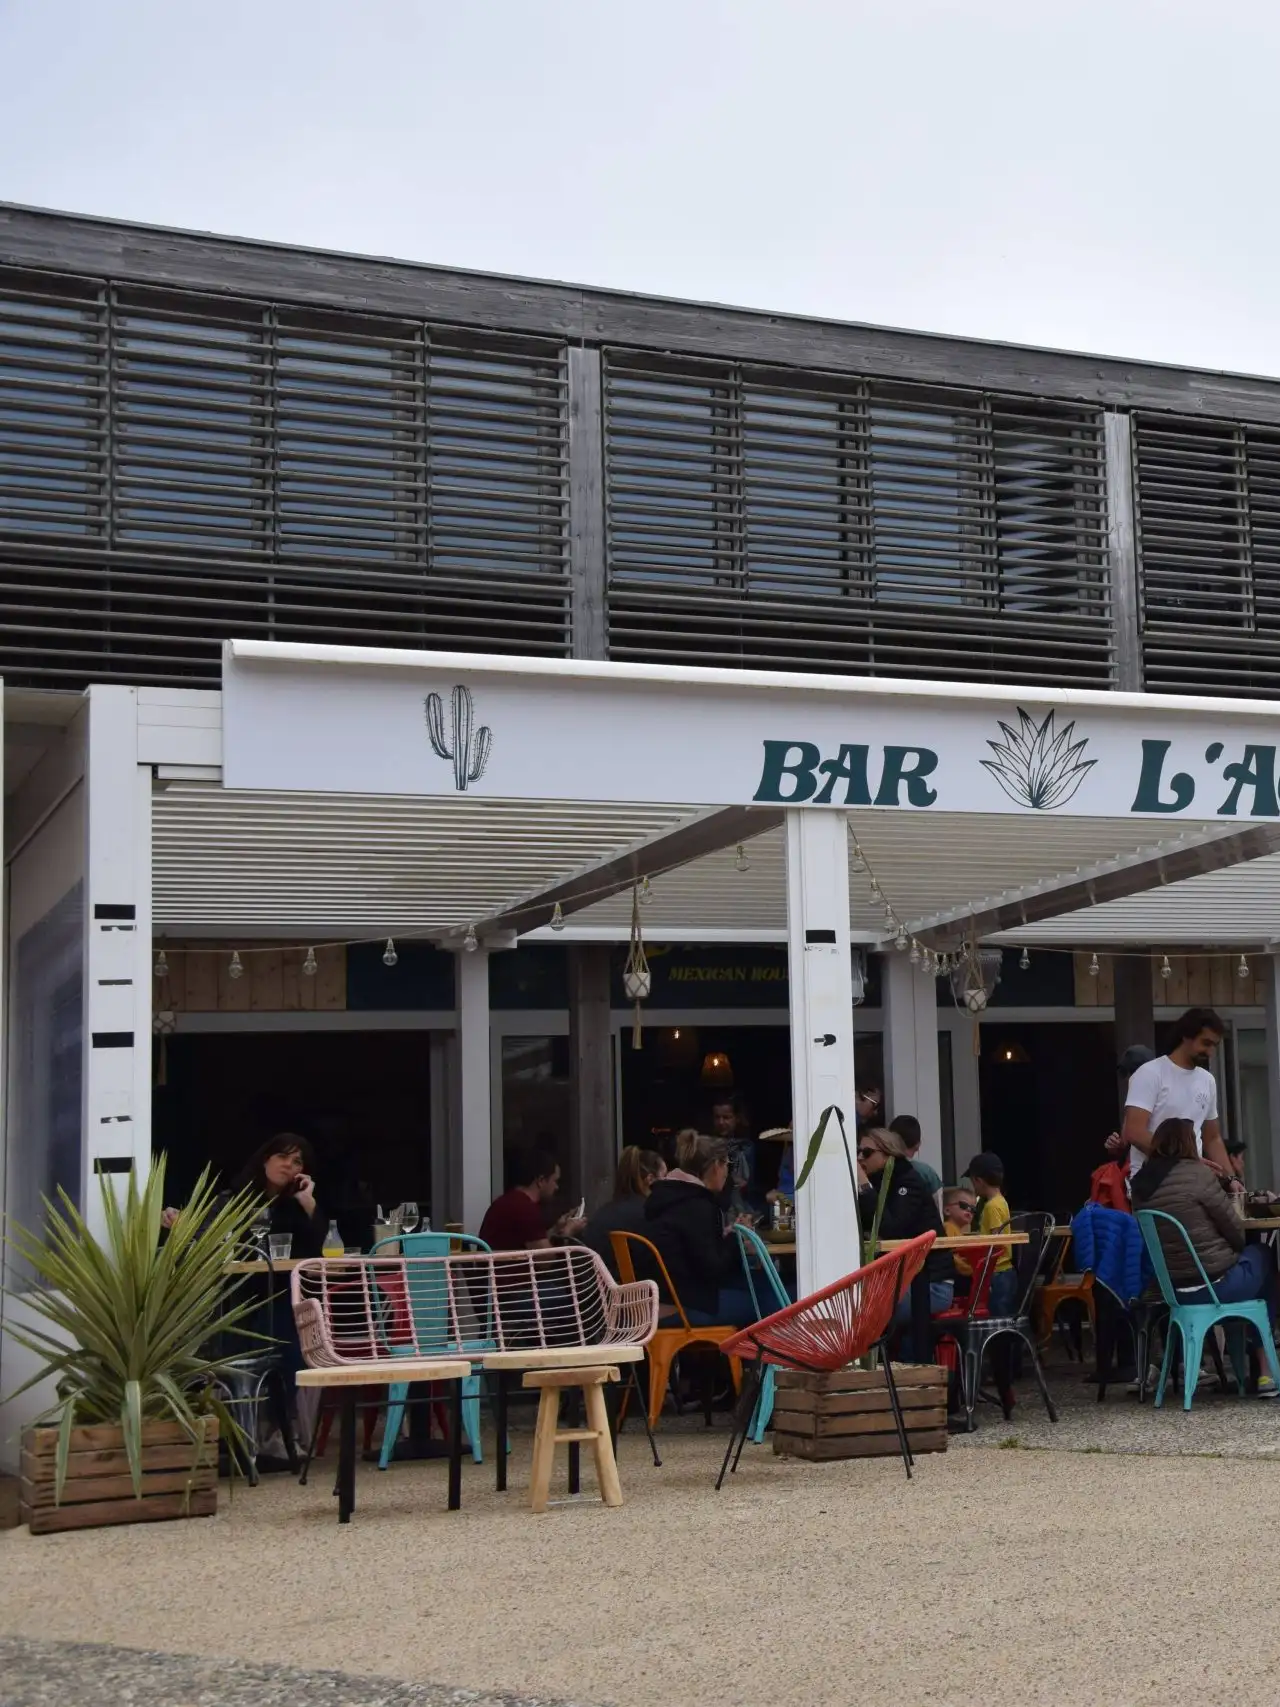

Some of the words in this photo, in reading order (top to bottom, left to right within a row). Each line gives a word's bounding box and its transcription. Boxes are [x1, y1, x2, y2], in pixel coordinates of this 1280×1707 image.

[752, 739, 939, 807] BAR
[667, 966, 746, 982] MEXICAN
[750, 966, 789, 982] HOU
